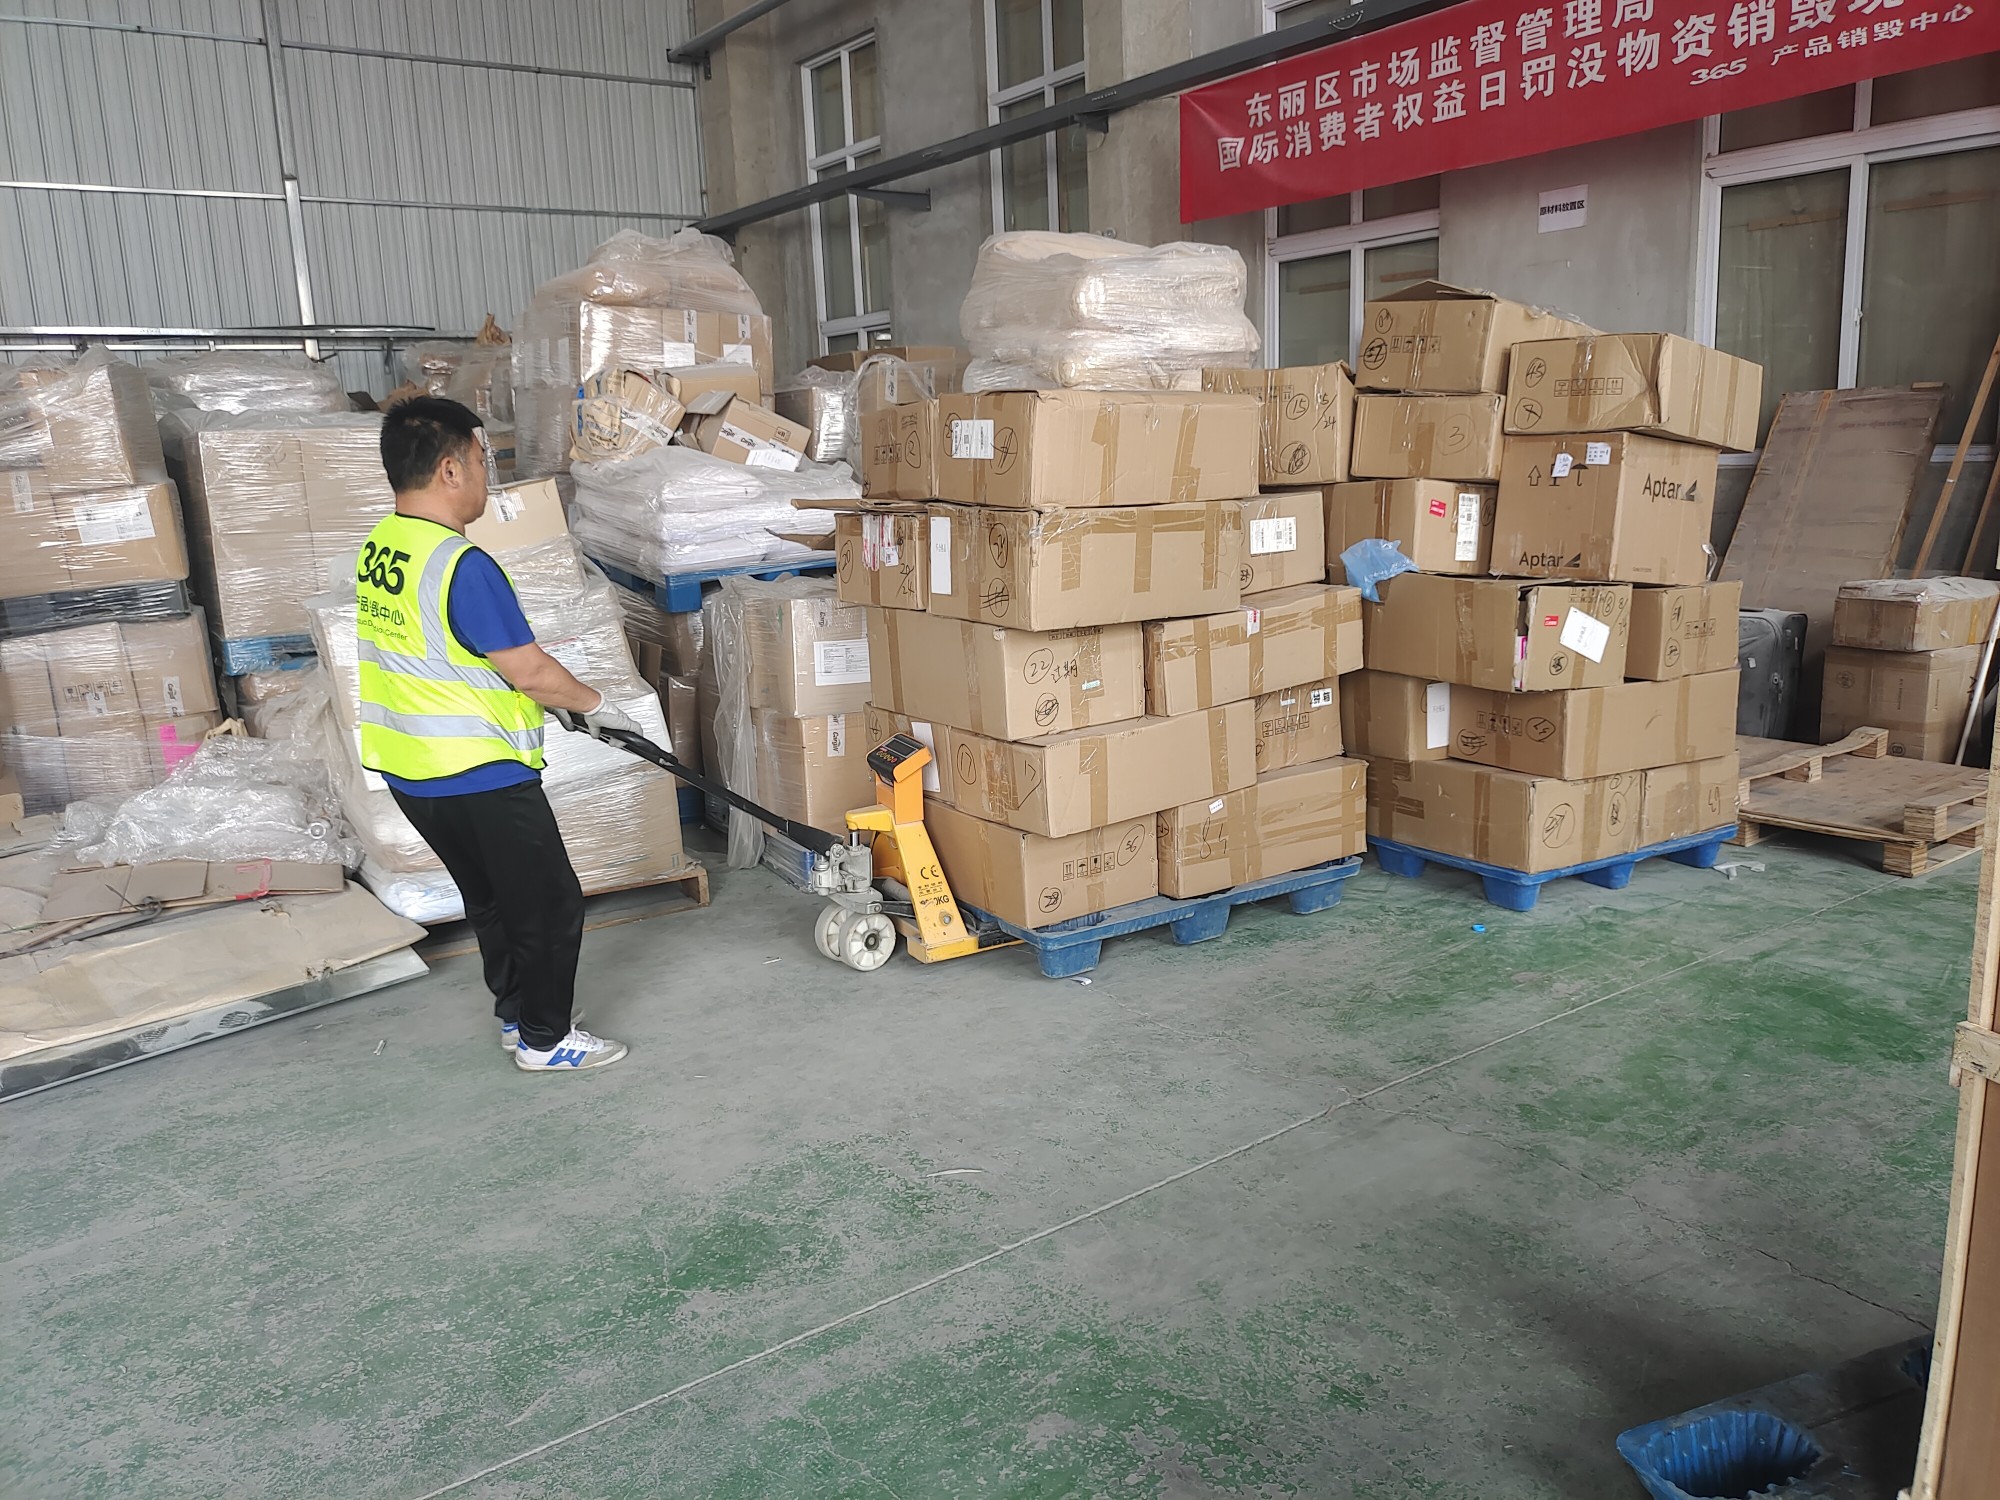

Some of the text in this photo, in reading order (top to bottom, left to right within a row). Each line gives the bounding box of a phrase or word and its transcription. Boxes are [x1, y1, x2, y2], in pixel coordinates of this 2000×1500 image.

[1245, 0, 1654, 128] 东丽区市场监督管理局
[1690, 3, 1975, 85] 365 产品销毁中心
[1642, 472, 1682, 503] Aptar
[358, 541, 411, 595] 365
[1519, 551, 1564, 570] Aptar
